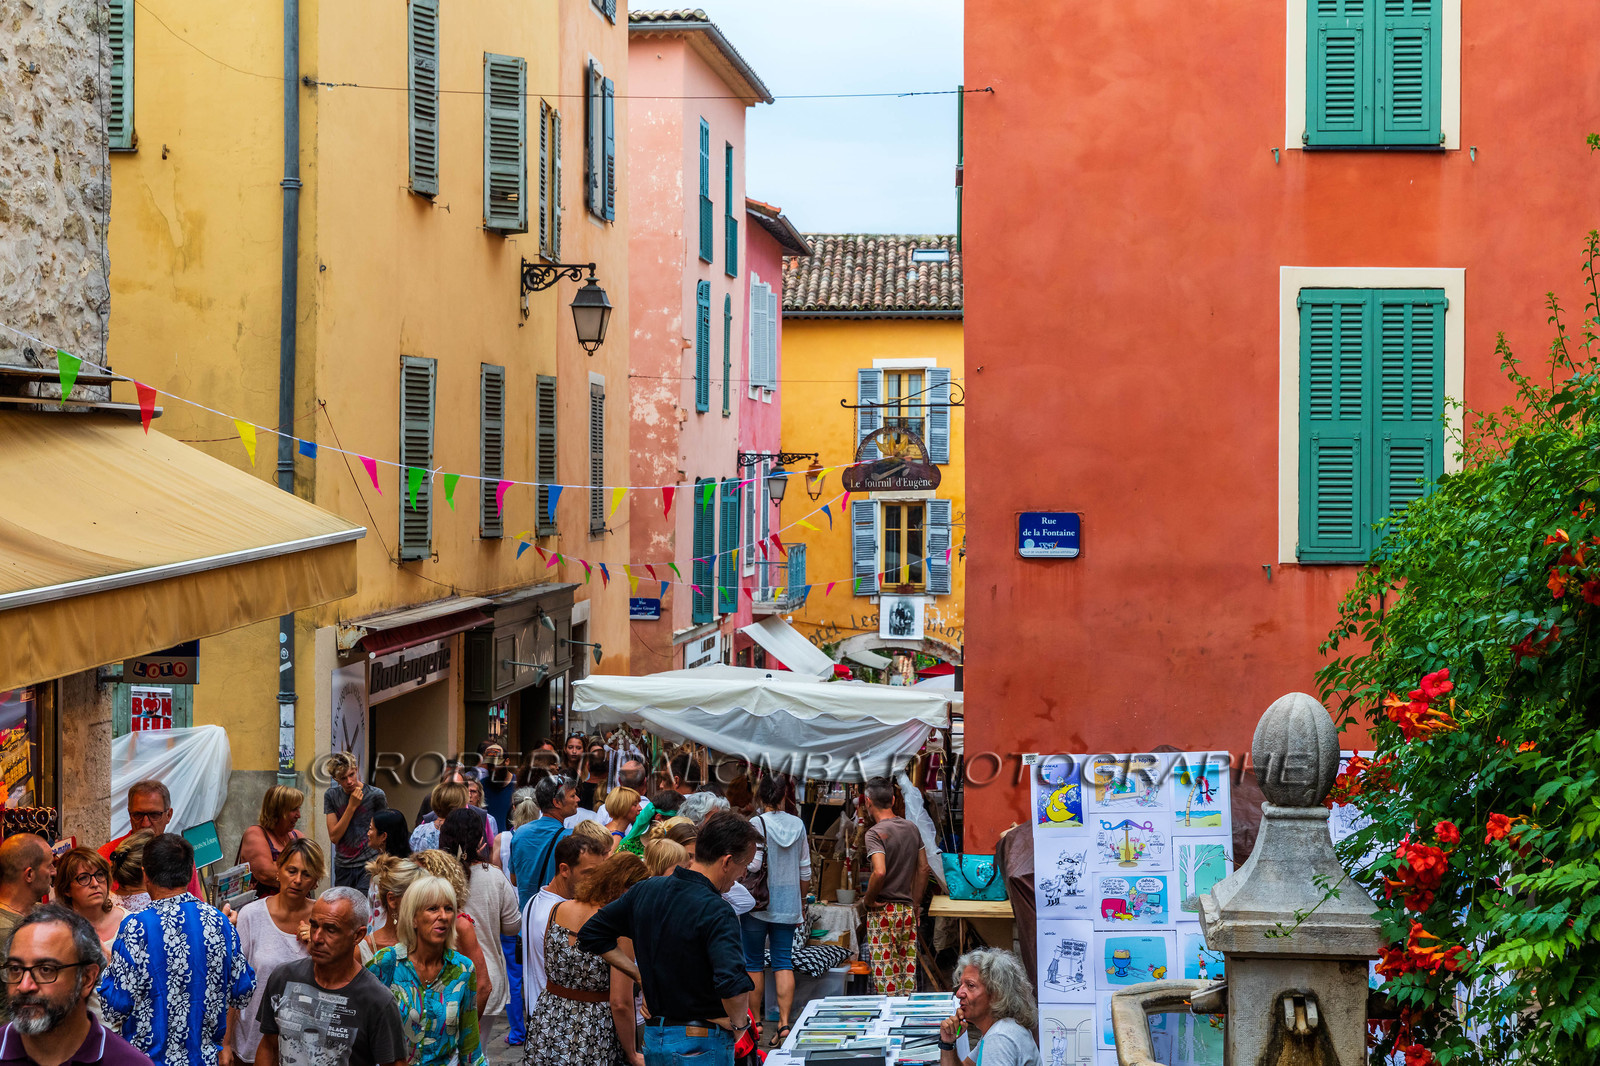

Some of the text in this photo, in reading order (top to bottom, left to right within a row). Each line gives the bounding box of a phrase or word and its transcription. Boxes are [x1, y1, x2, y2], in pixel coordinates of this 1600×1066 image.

[850, 477, 933, 489] Le fournil d'Eugène
[1041, 516, 1057, 525] Rue
[1022, 528, 1076, 537] de la Fontaine
[808, 620, 842, 646] ôtel
[132, 661, 188, 679] LOTO
[370, 642, 451, 695] Boulangerie
[320, 1011, 341, 1019] BLACK
[328, 1025, 349, 1033] BLACK
[326, 1031, 350, 1039] BRICKS
